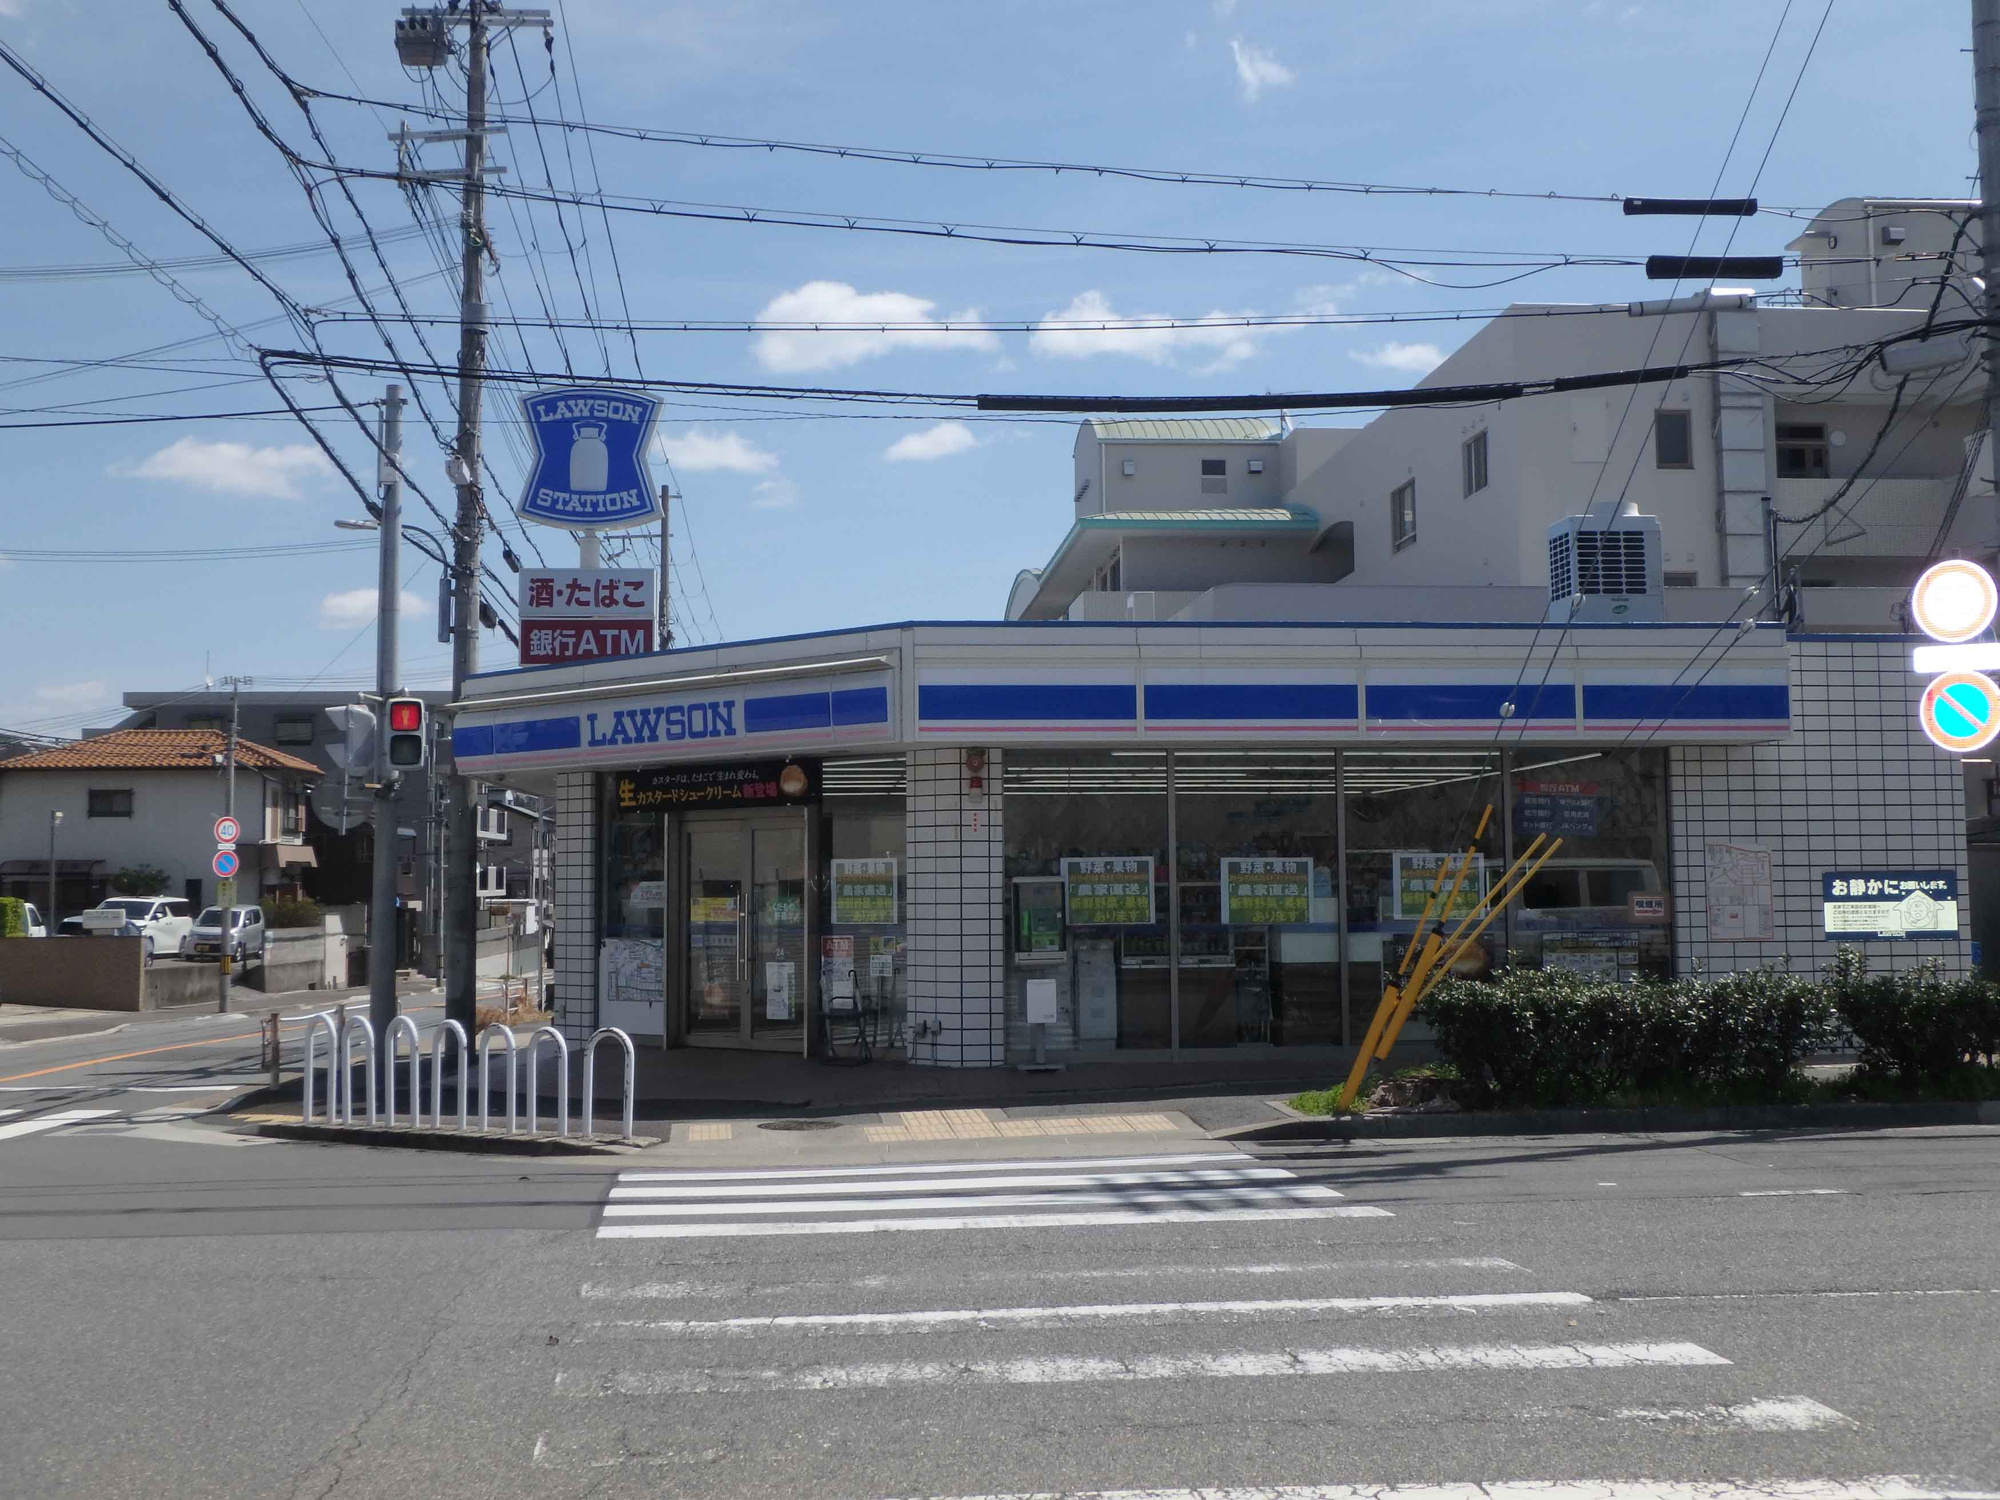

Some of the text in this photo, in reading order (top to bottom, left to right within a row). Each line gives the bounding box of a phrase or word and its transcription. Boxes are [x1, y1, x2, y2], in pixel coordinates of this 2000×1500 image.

[536, 400, 643, 424] LAWSON
[536, 487, 641, 513] STATION
[528, 577, 645, 608] 酒・たばこ
[529, 629, 645, 656] 銀行ATM
[587, 700, 737, 747] LAWSON
[220, 824, 234, 836] 40
[1239, 860, 1297, 874] 野菜・果物
